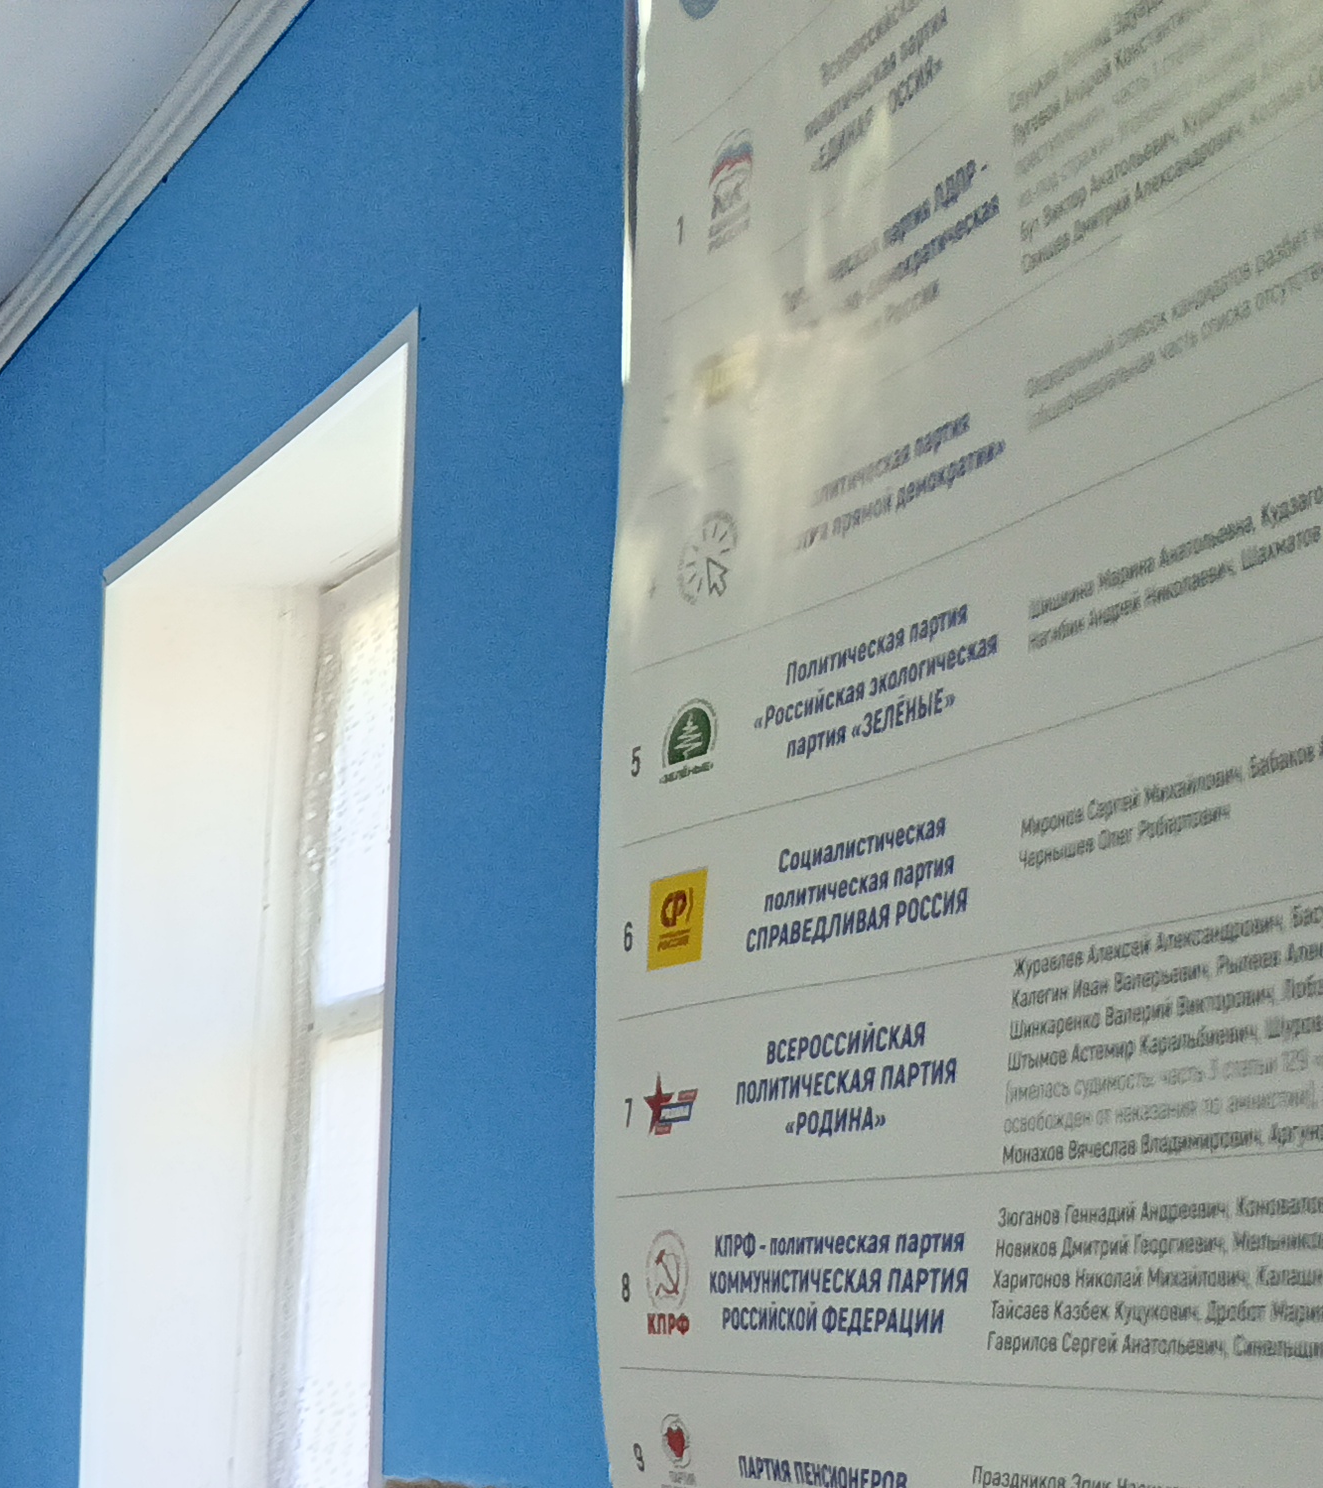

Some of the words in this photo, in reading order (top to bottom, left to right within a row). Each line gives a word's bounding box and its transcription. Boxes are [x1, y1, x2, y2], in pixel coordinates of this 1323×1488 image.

[786, 631, 904, 686] Политическая
[909, 603, 968, 648] партия
[753, 681, 865, 729] «Российская
[869, 634, 998, 697] экологическая
[787, 724, 846, 759] партия
[851, 687, 956, 738] «ЗЕЛЁНЫЕ»
[631, 746, 641, 777] 5
[779, 816, 946, 874] Социалистическая
[764, 868, 888, 913] политическая
[894, 855, 954, 895] партия
[745, 902, 889, 953] СПРАВЕДЛИВАЯ
[895, 887, 968, 927] РОССИЯ
[623, 921, 633, 952] 6
[1087, 932, 1151, 965] Алексей
[1072, 977, 1109, 999] Иван
[766, 1021, 926, 1065] ВСЕРОССИЙСКАЯ
[736, 1067, 875, 1105] ПОЛИТИЧЕСКАЯ
[881, 1057, 957, 1092] ПАРТИЯ
[624, 1098, 633, 1128] 7
[785, 1106, 886, 1137] «РОДИНА»
[1002, 1142, 1064, 1165] Монахов
[1068, 1137, 1137, 1161] Вячеслав
[997, 1205, 1060, 1229] Зюганов
[1064, 1201, 1135, 1227] Геннадий
[715, 1232, 755, 1258] КПРФ
[770, 1234, 889, 1258] политическая
[895, 1232, 965, 1259] партия
[995, 1238, 1056, 1259] Новиков
[1060, 1234, 1128, 1260] Дмитрий
[621, 1273, 630, 1302] 8
[709, 1267, 881, 1294] КОММУНИСТИЧЕСКАЯ
[887, 1267, 968, 1294] ПАРТИЯ
[992, 1269, 1070, 1294] Харитонов
[1074, 1266, 1142, 1289] Николай
[646, 1312, 690, 1335] КПРФ
[722, 1301, 816, 1333] РОССИЙСКОЙ
[821, 1305, 944, 1337] ФЕДЕРАЦИИ
[990, 1300, 1049, 1321] Тайсаев
[1053, 1300, 1109, 1321] Казбек
[986, 1331, 1056, 1353] Гаврилов
[1061, 1331, 1116, 1358] Сергей
[633, 1443, 645, 1473] 9
[738, 1455, 791, 1483] ПАРТИЯ
